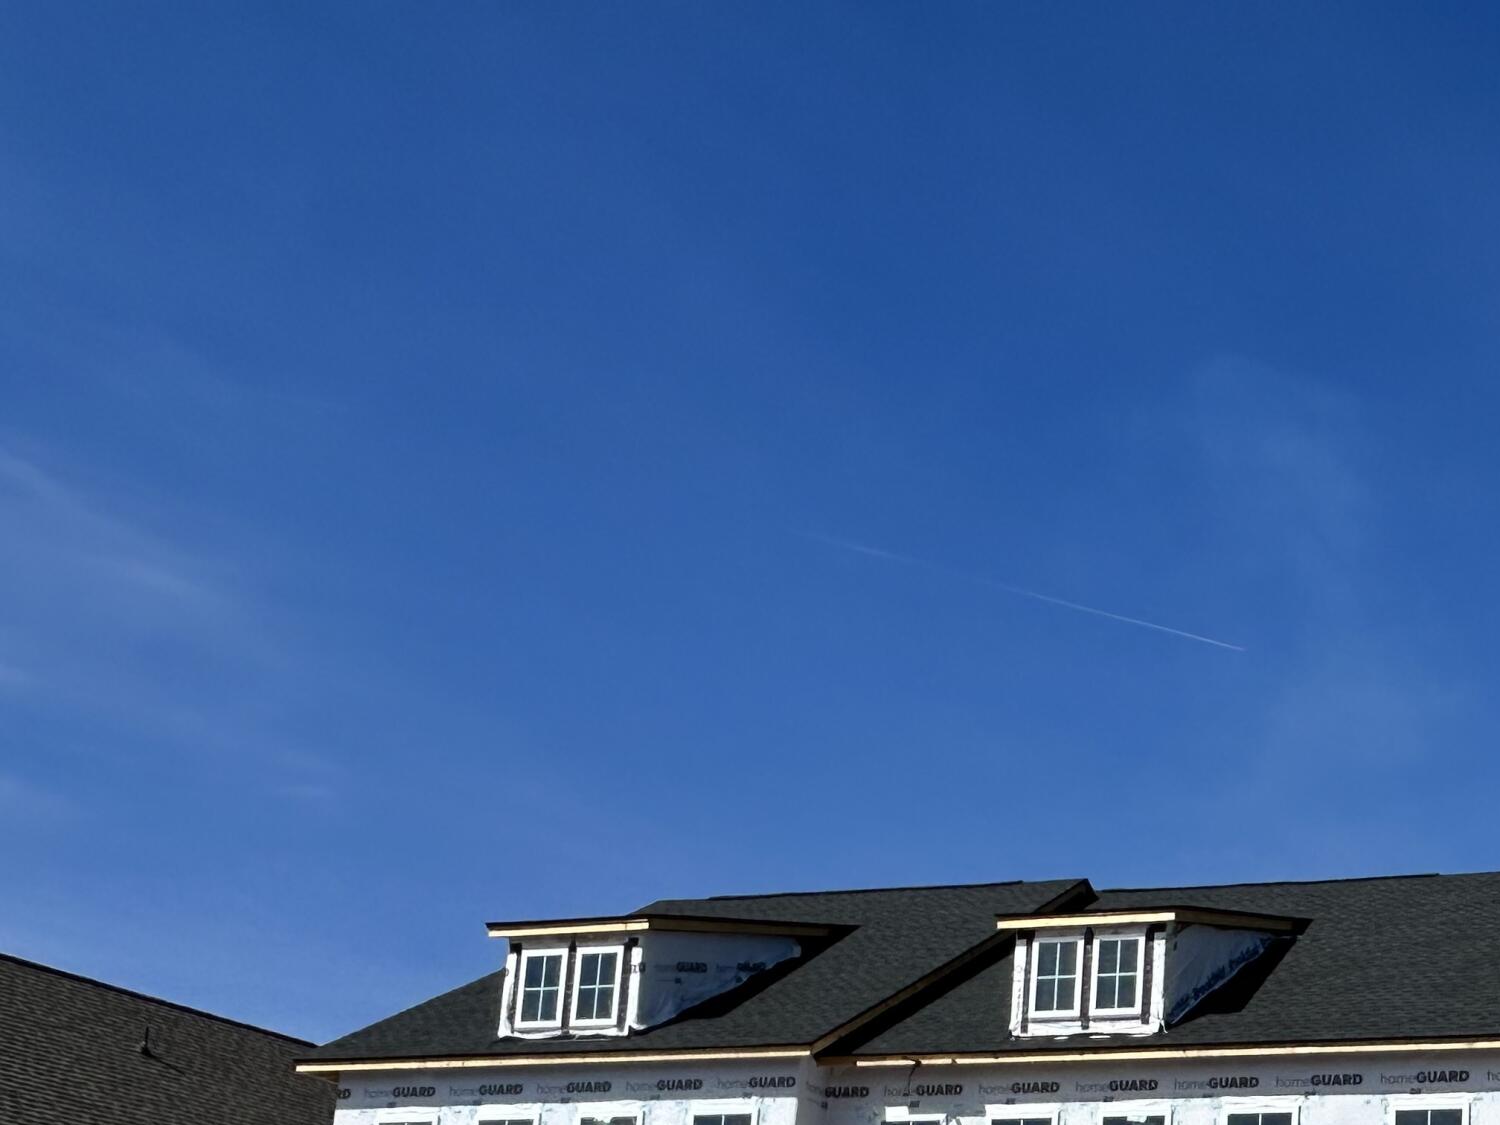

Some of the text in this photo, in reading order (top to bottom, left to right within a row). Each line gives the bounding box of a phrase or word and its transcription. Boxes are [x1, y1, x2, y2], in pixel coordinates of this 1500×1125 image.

[717, 1076, 796, 1089] homeGUARD
[1174, 1077, 1259, 1090] homeGUARD
[1276, 1074, 1362, 1087] homeGUARD
[1381, 1070, 1469, 1084] homeGUARD
[450, 1084, 523, 1096] homeGUARD
[536, 1081, 612, 1094] homeGUARD
[626, 1079, 703, 1092] homeGUARD
[978, 1082, 1060, 1094] homeGUARD
[1075, 1079, 1158, 1091] homeGUARD
[364, 1086, 436, 1098] homeGUARD
